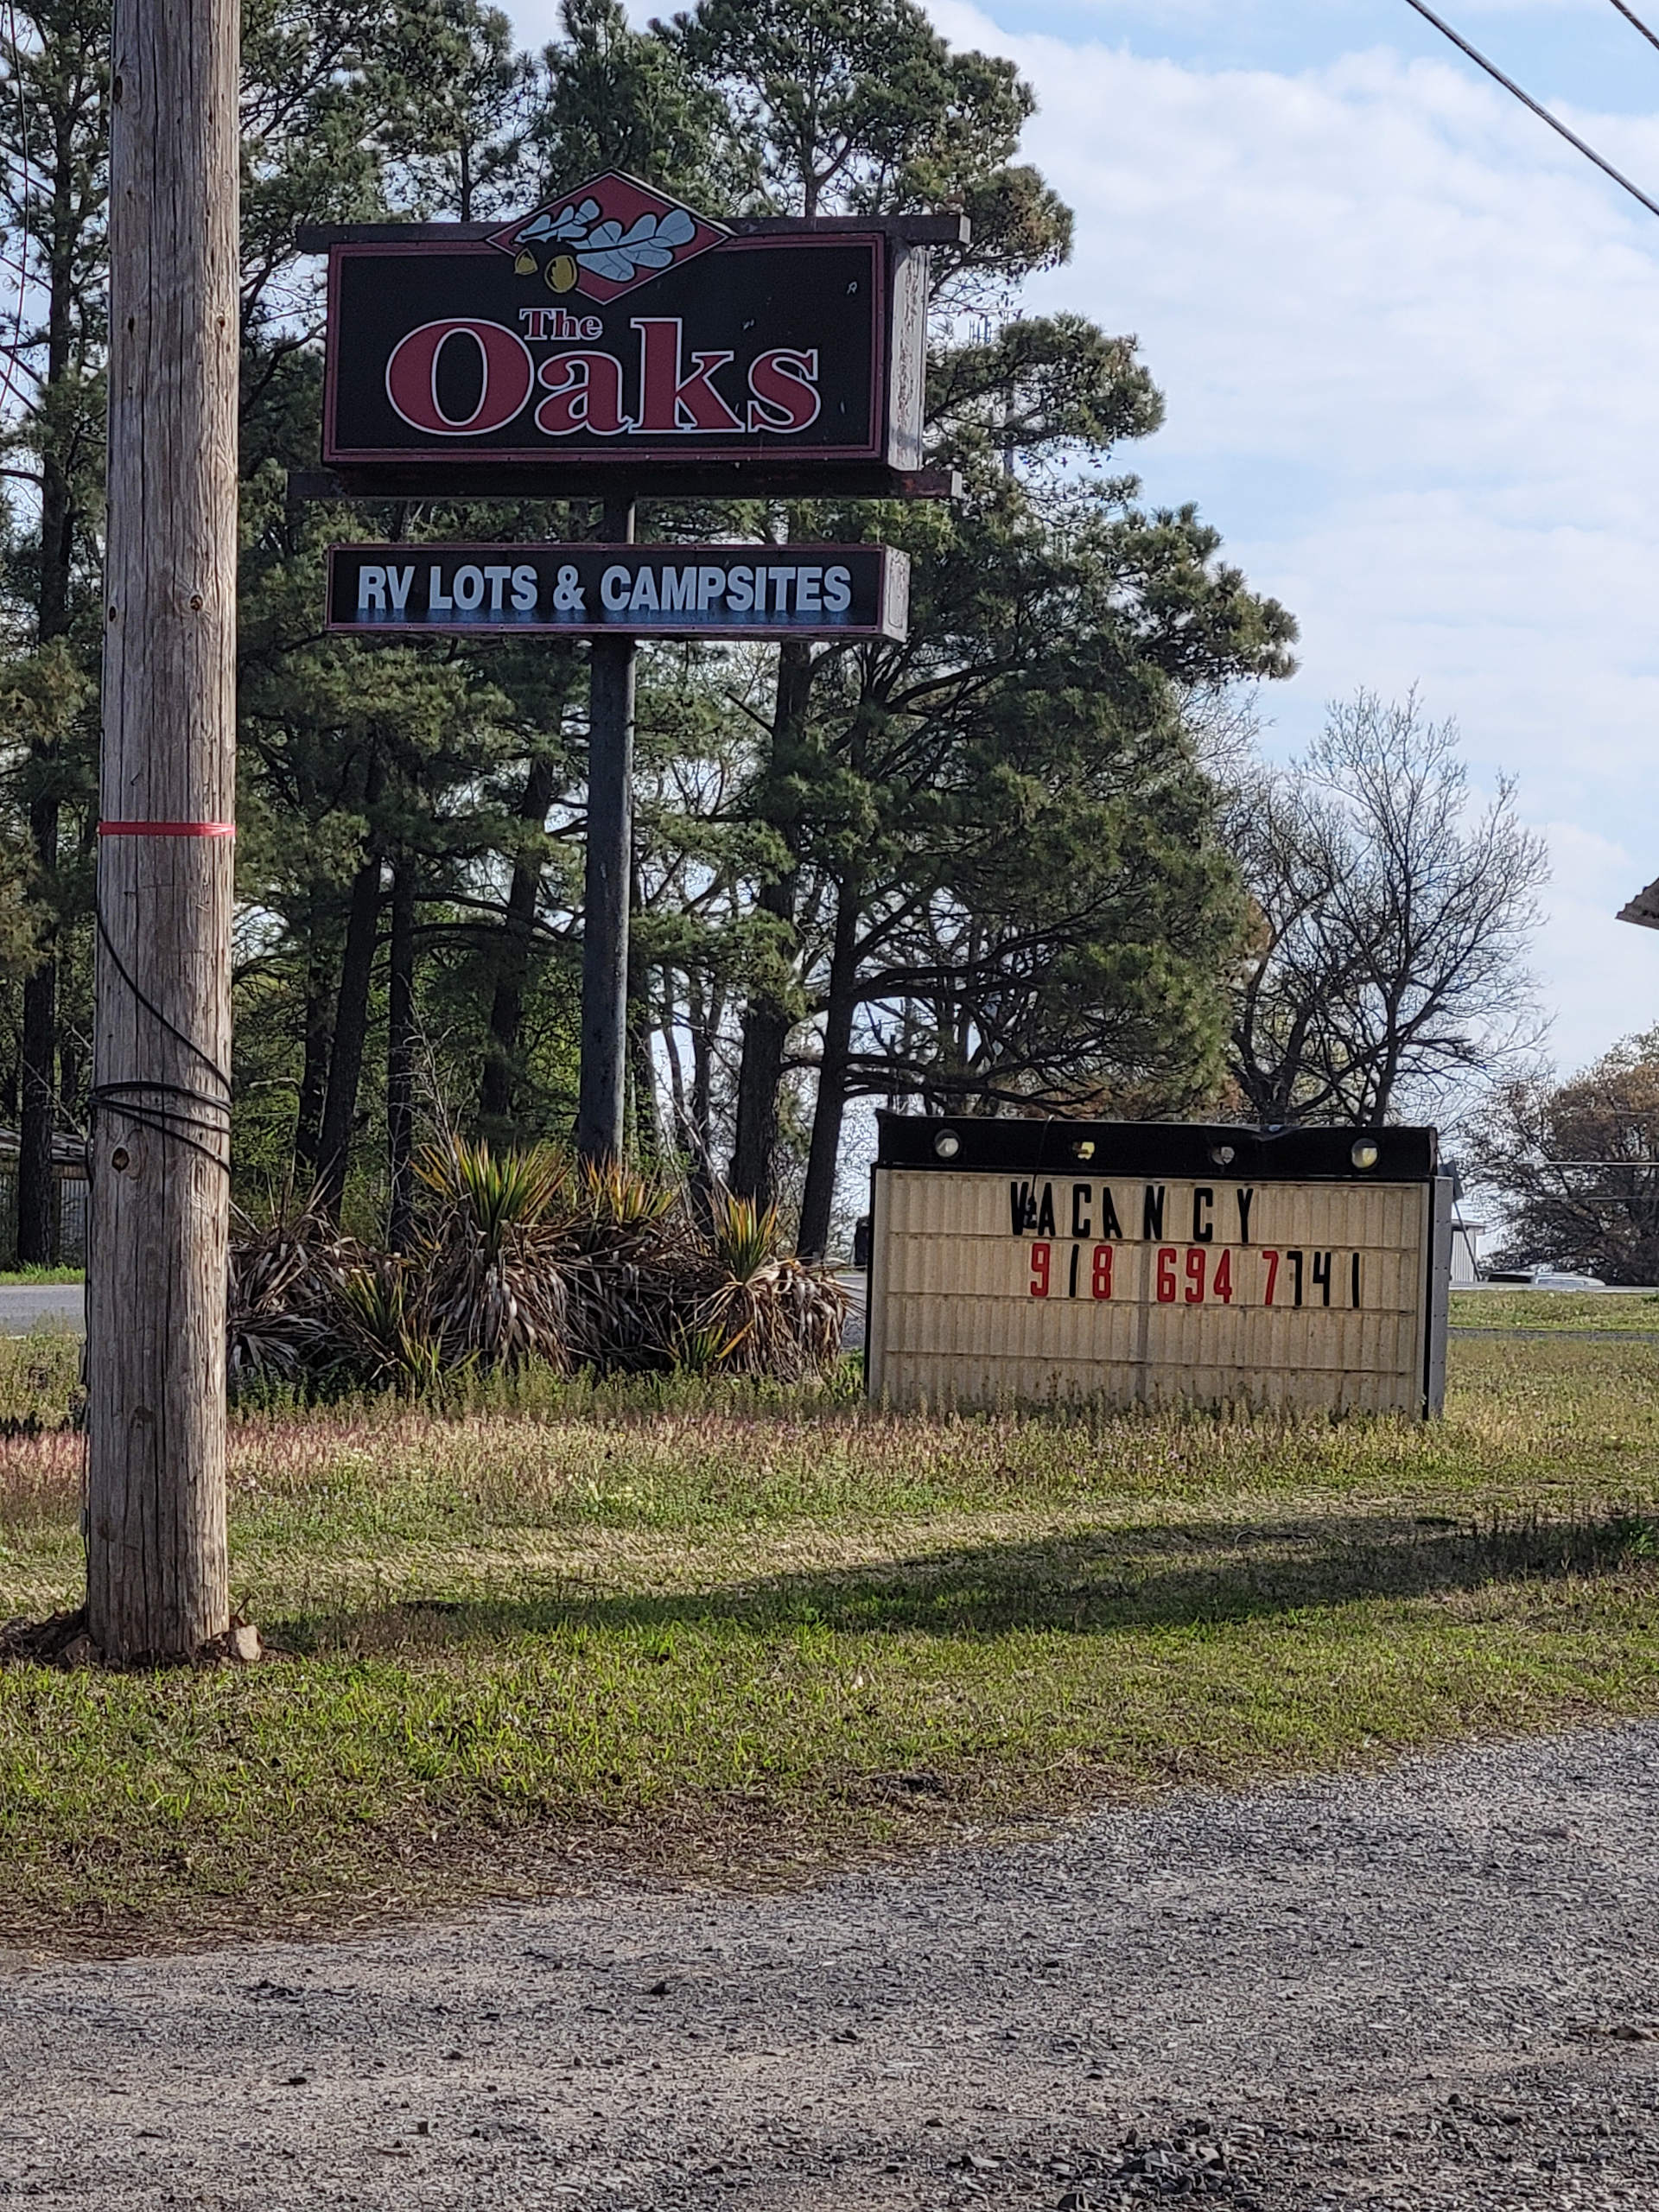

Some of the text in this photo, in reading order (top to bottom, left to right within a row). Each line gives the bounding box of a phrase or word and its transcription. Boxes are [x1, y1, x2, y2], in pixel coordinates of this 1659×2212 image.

[519, 307, 603, 341] The
[385, 317, 821, 435] Oaks
[359, 565, 851, 612] RV LOTS & CAMPSITES
[1010, 1180, 1254, 1243] VACANCY
[1031, 1243, 1361, 1308] 918 694 7741
